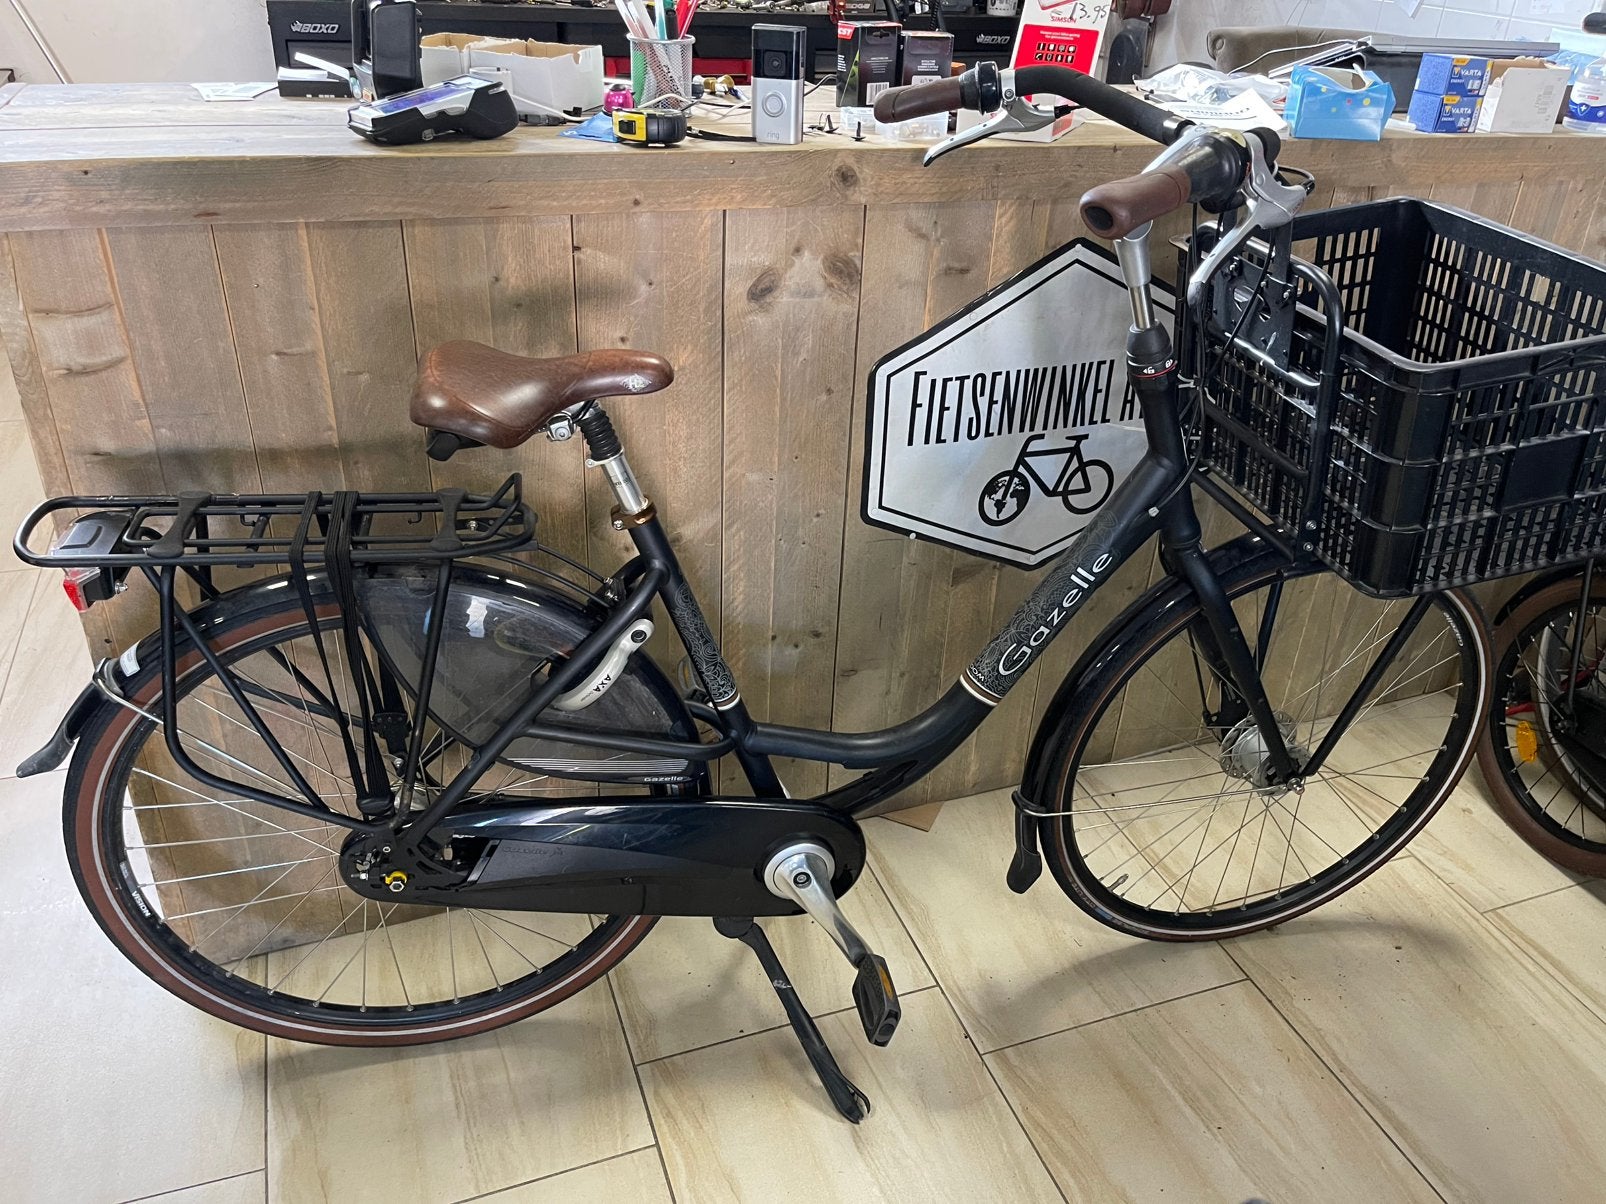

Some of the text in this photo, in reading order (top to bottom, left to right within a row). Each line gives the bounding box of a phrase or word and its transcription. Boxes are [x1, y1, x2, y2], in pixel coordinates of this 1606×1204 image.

[1050, 16, 1077, 24] SIMSON
[1069, 2, 1109, 24] 13.95
[300, 23, 339, 34] BOXO
[982, 35, 1011, 45] BOXO
[1461, 69, 1482, 77] VARTA
[1451, 107, 1472, 115] VARTA
[1119, 376, 1145, 421] A
[999, 553, 1113, 676] Gazelle
[592, 673, 612, 692] AXA
[131, 890, 152, 917] VISION
